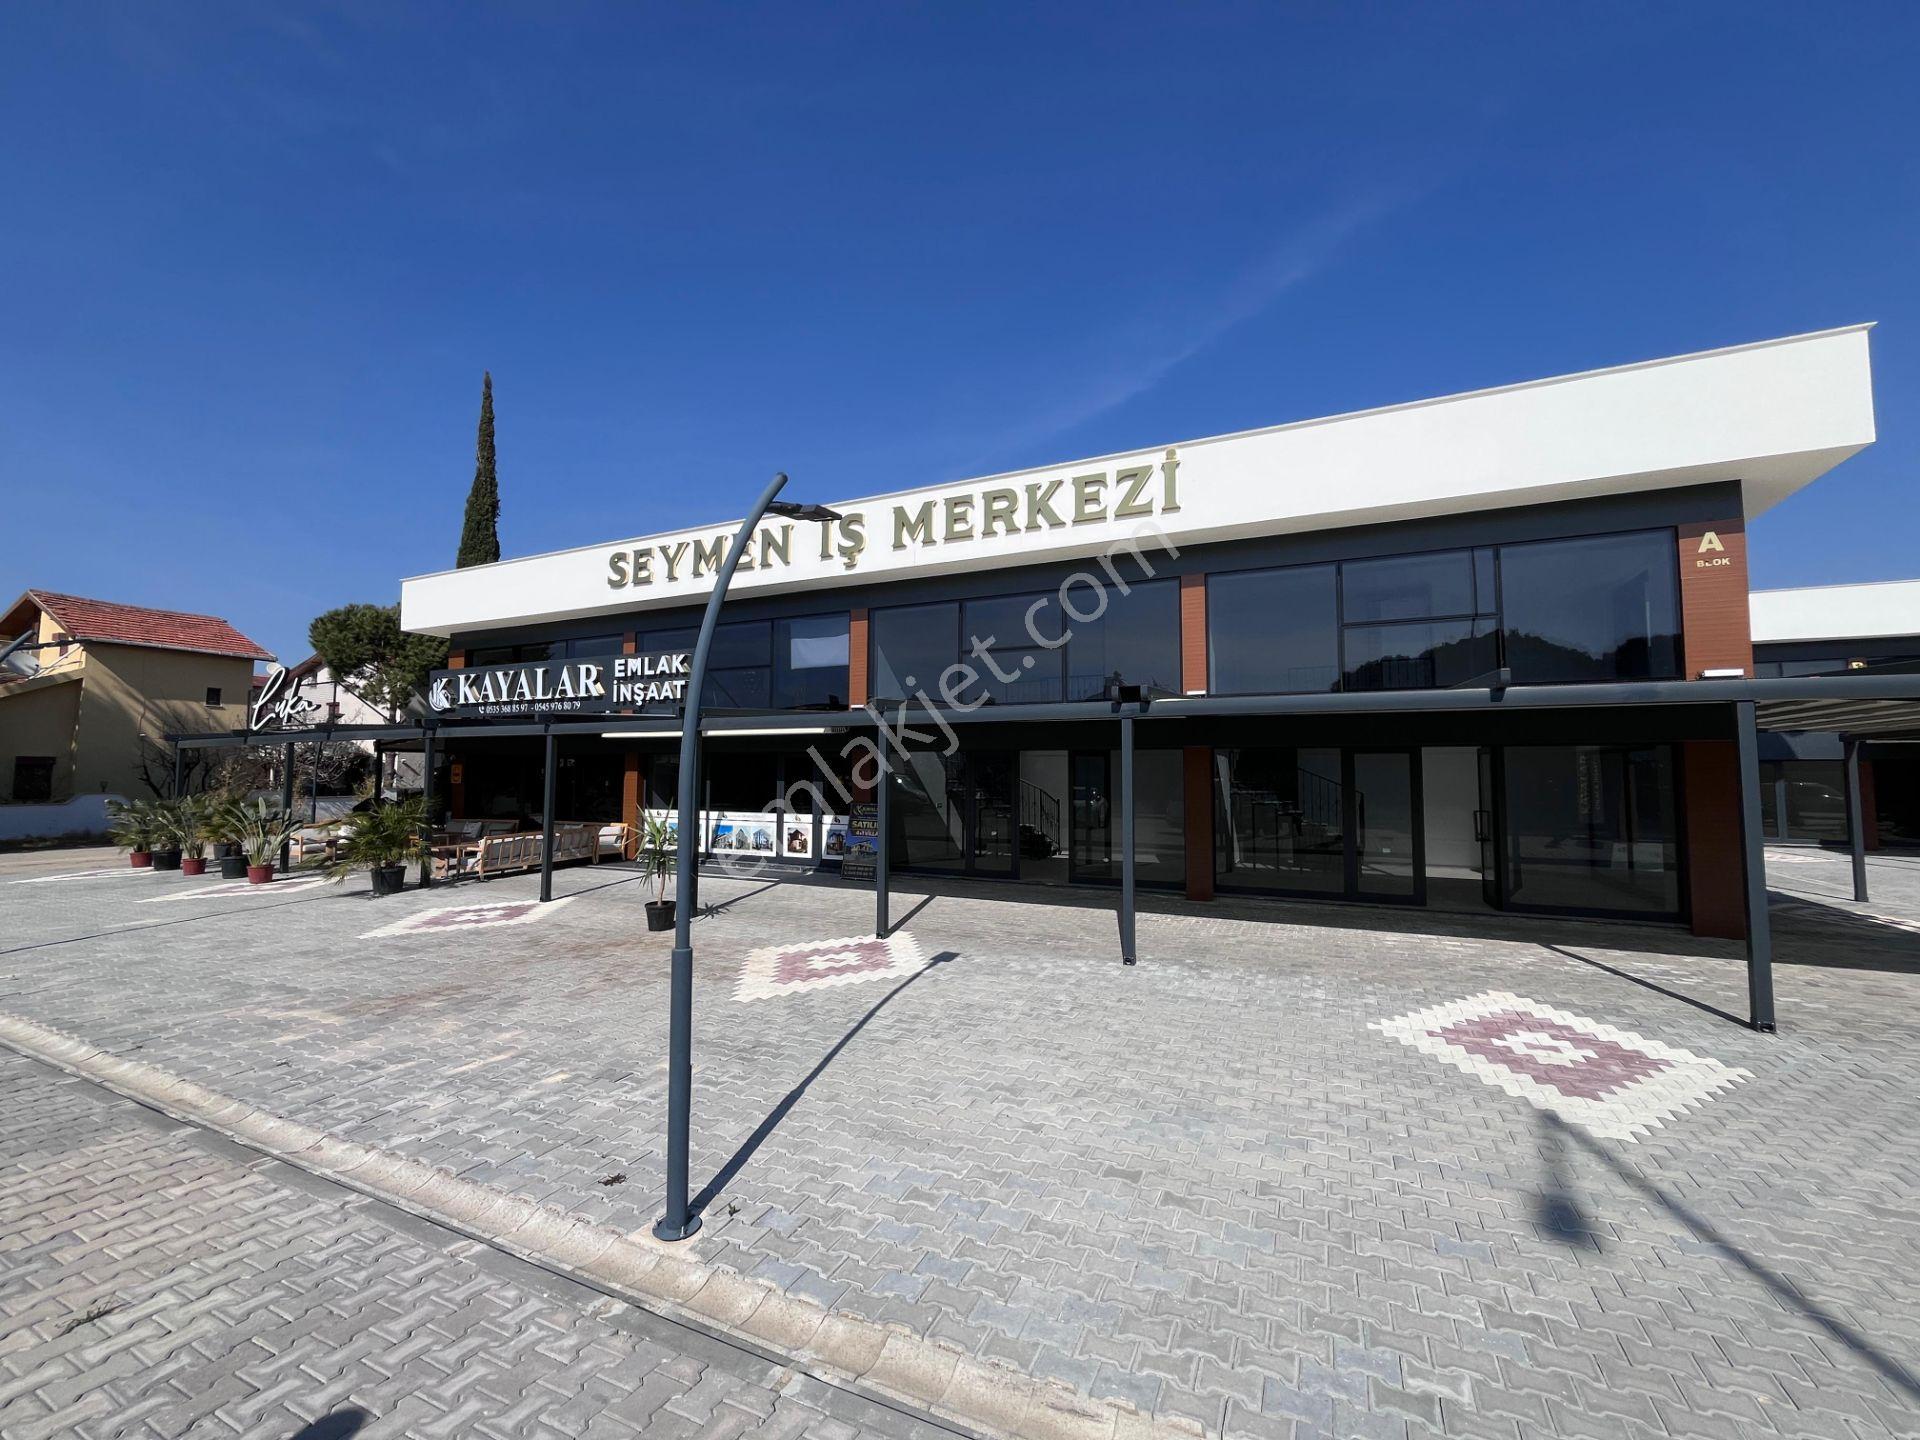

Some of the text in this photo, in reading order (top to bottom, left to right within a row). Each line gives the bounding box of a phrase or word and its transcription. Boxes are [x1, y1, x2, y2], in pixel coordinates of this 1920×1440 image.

[892, 448, 1181, 551] MERKEZİ
[1697, 531, 1725, 553] A
[1696, 557, 1731, 567] BLOK
[614, 653, 687, 677] EMLAK
[457, 664, 601, 704] KAYALAR
[612, 680, 686, 706] İNŞAAT
[520, 703, 528, 712] 97
[534, 702, 549, 711] 0545
[550, 701, 562, 711] 976
[573, 700, 580, 710] 79
